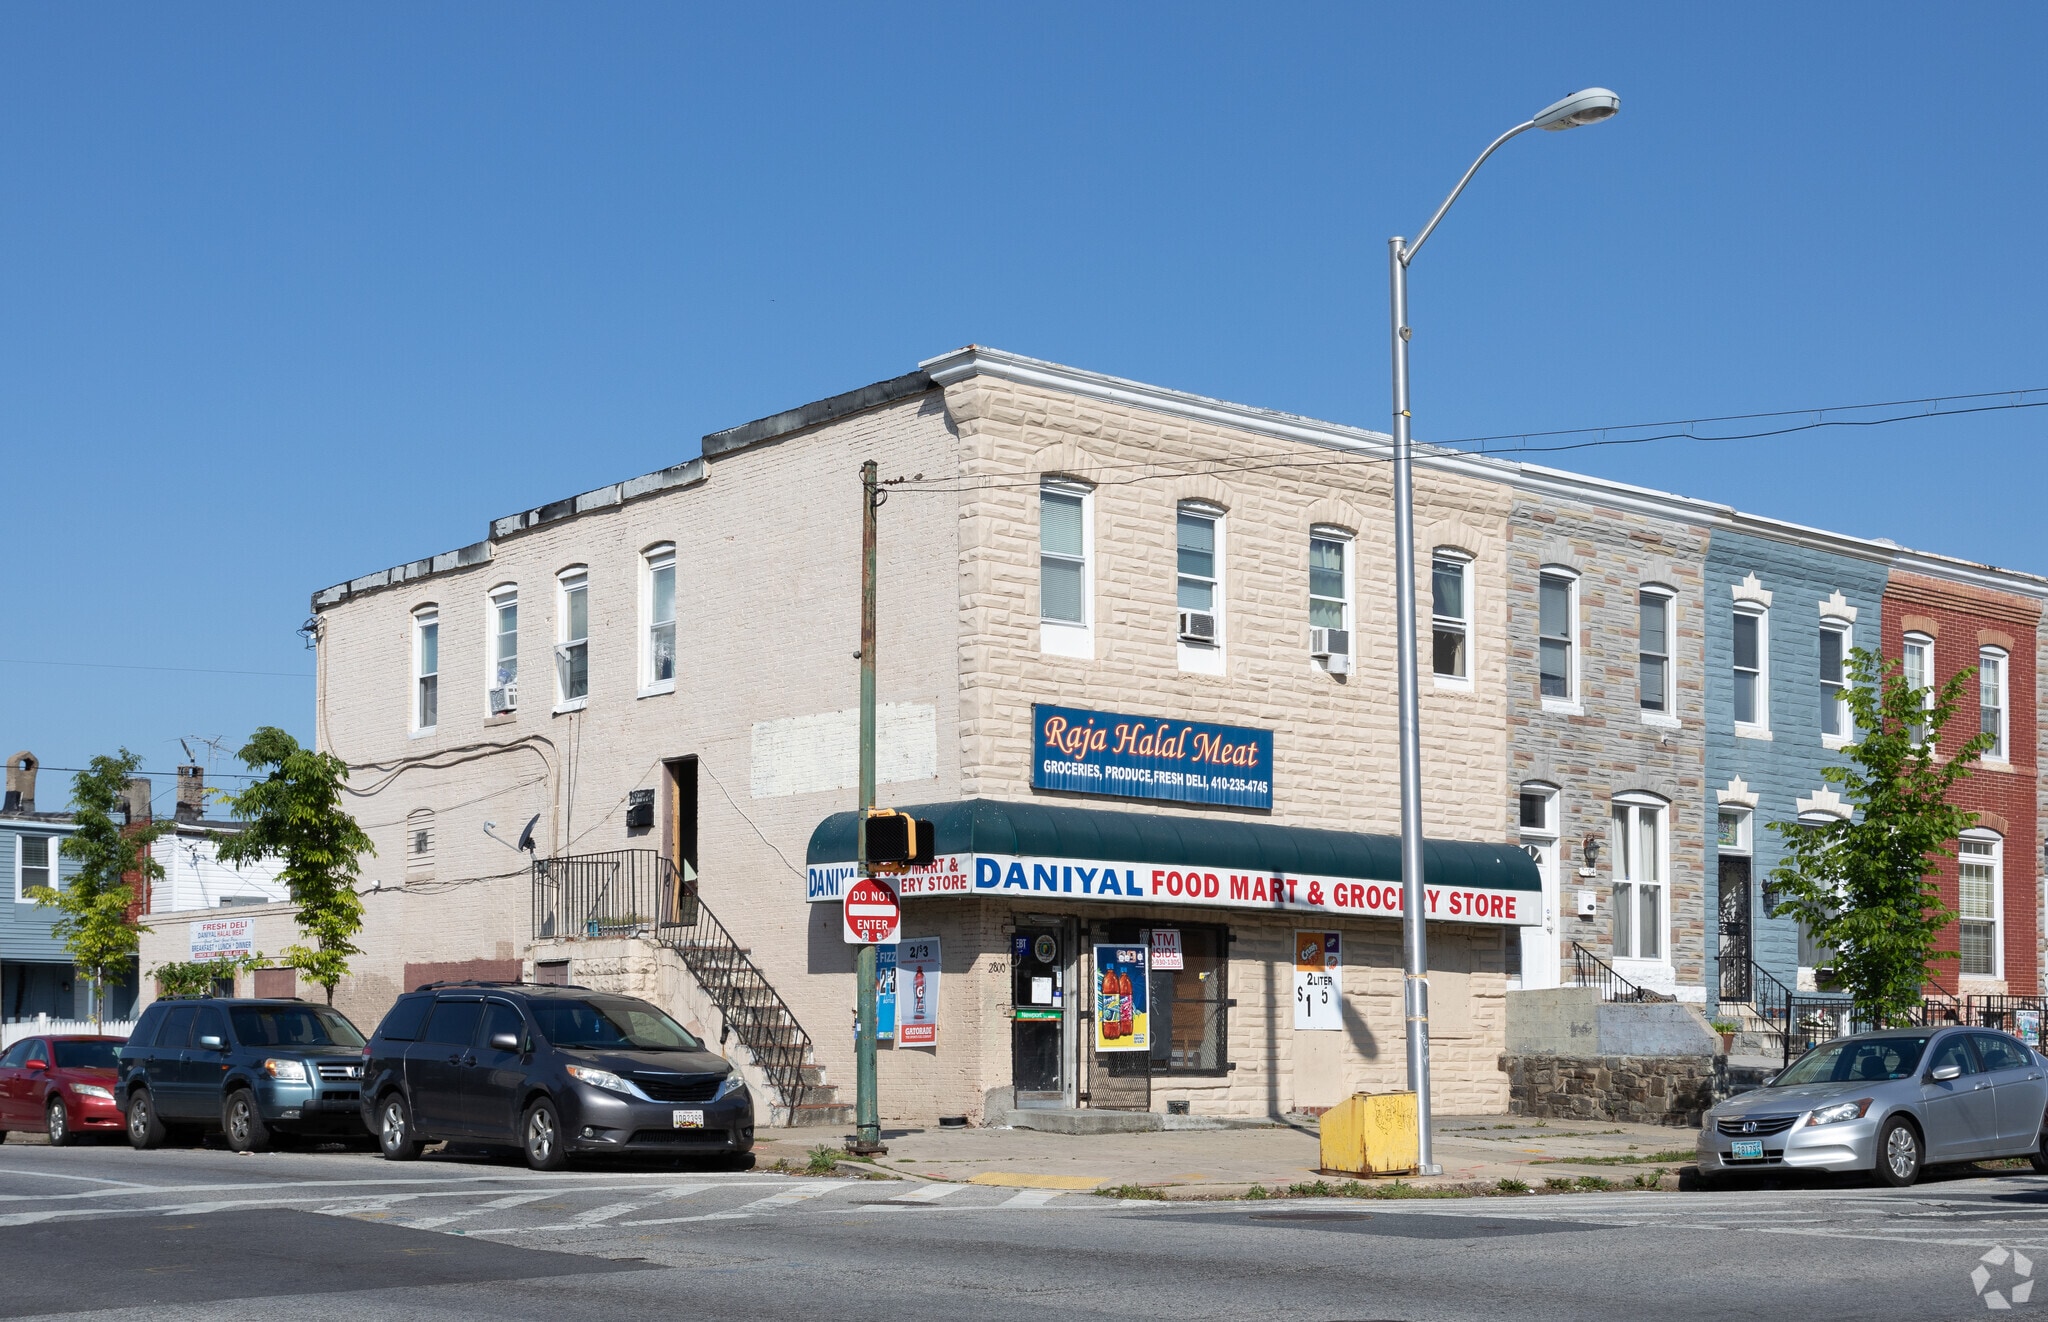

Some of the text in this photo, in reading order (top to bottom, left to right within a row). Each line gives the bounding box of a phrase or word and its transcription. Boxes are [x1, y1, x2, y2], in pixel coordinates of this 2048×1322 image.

[1045, 716, 1259, 767] Raja Halal Meat
[1043, 760, 1103, 781] GROCERIES,
[1186, 774, 1209, 791] DELI,
[1211, 777, 1268, 794] 410-235-4745
[808, 867, 854, 898] DANIY
[949, 857, 958, 873] &
[928, 874, 967, 892] STORE
[975, 857, 1517, 919] DANIYAL FOOD MART & GROCY STORE
[853, 891, 891, 902] DO NOT
[857, 920, 888, 930] ENTER
[192, 941, 251, 952] BREAKFAST LUNCH DINNER
[880, 952, 896, 962] FIZZ
[1152, 948, 1177, 958] NSIDE
[1021, 1011, 1043, 1019] Newport
[905, 1026, 932, 1036] GATORADE
